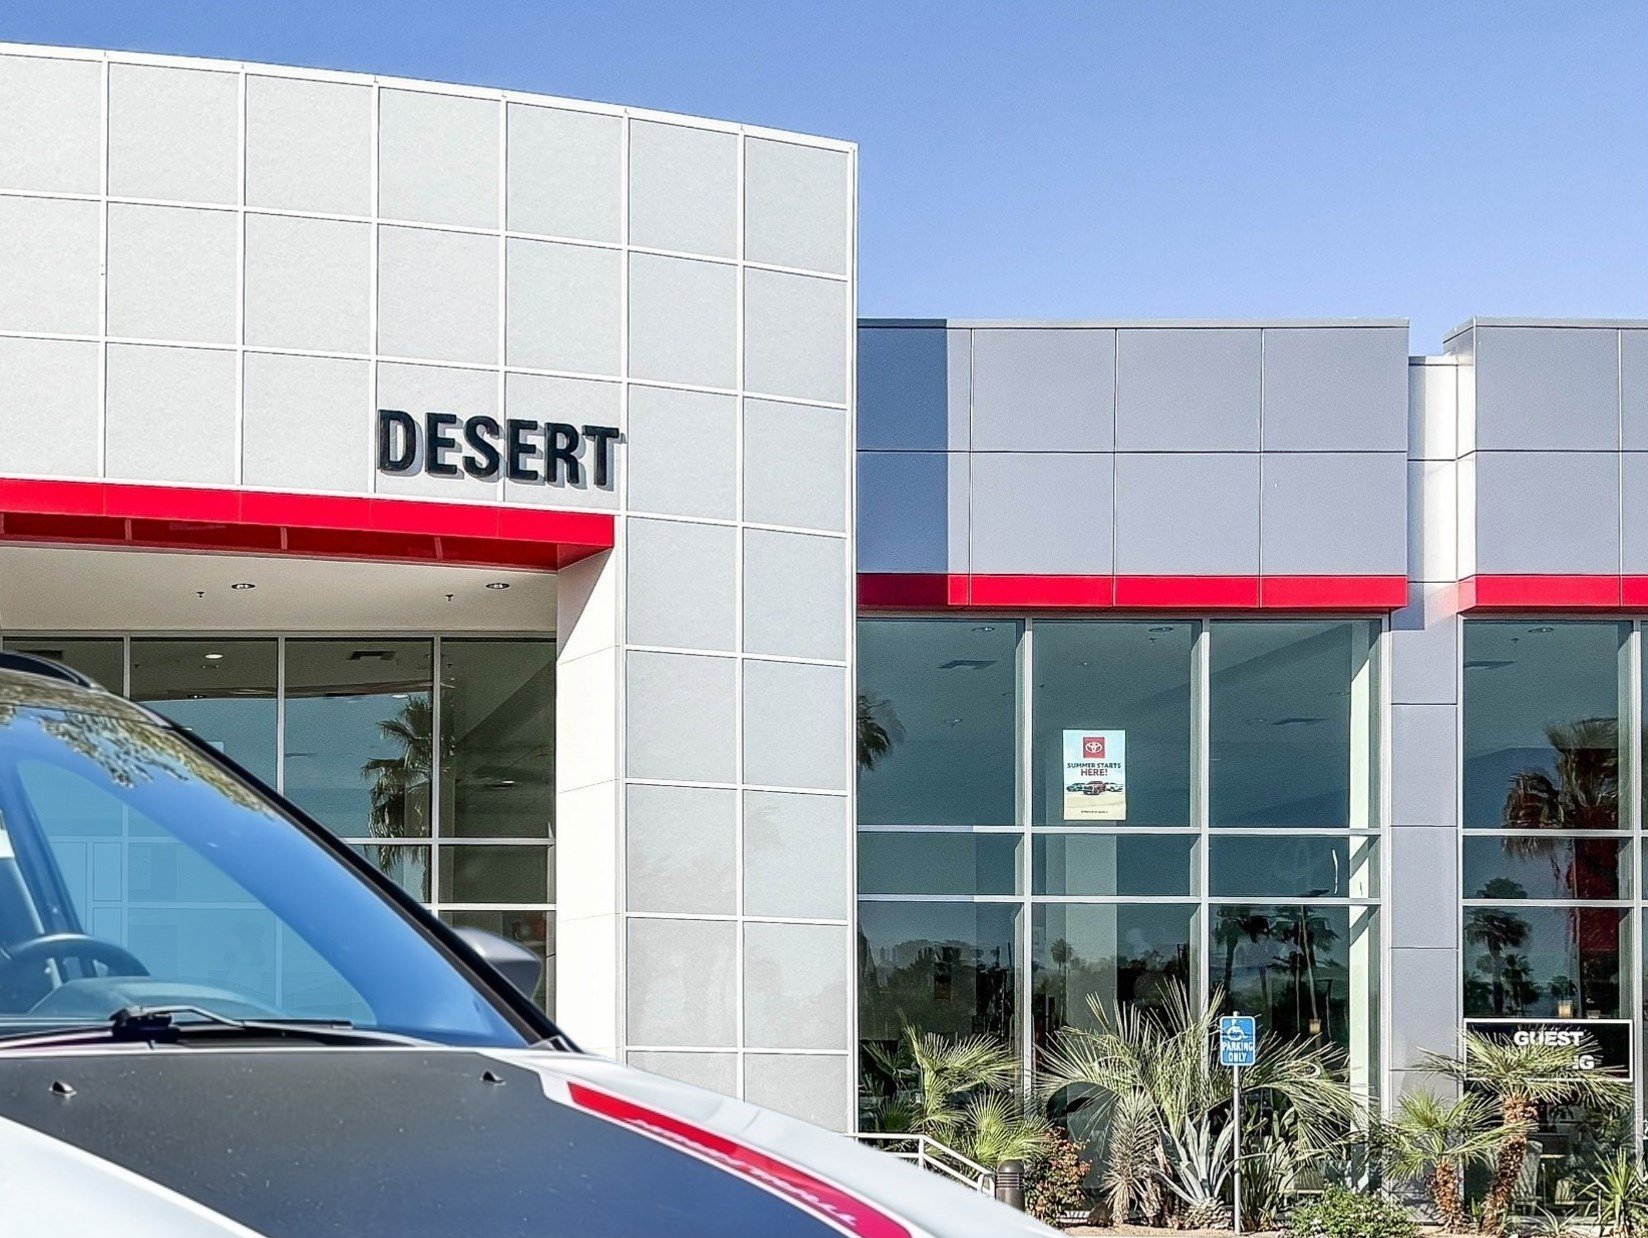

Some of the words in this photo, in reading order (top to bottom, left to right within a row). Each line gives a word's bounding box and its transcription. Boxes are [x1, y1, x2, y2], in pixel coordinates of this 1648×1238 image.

[376, 408, 621, 486] DESERT
[1080, 768, 1108, 776] HERE!
[1513, 1031, 1585, 1047] GUEST
[1222, 1041, 1254, 1052] PARKING
[1228, 1052, 1247, 1062] ONLY
